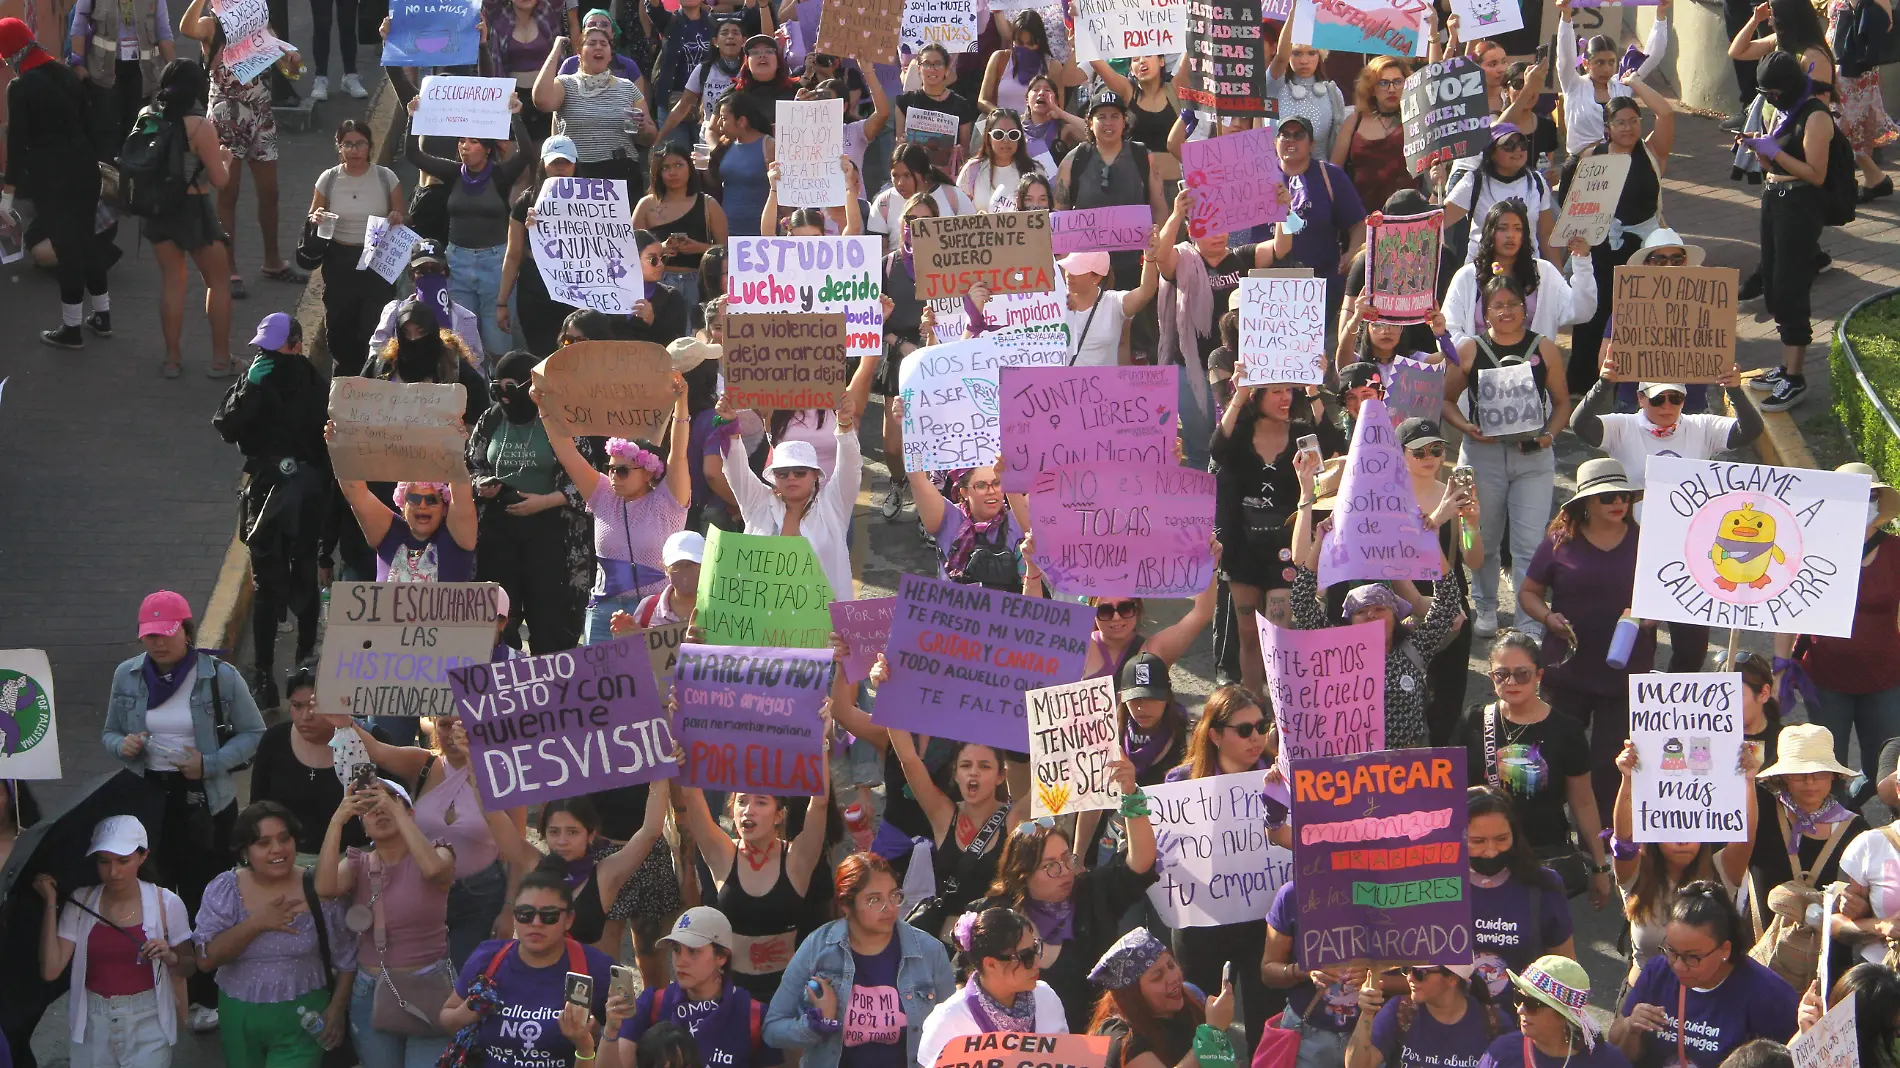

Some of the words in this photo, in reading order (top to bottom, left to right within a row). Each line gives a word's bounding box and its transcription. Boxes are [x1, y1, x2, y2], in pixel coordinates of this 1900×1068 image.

[405, 5, 420, 15] NO
[425, 5, 435, 13] LA
[439, 5, 468, 17] MUSA
[941, 1, 971, 12] MUJER
[1241, 8, 1253, 21] A
[951, 15, 963, 24] de
[1139, 9, 1178, 27] VIENE
[1100, 36, 1114, 52] LA
[1189, 58, 1197, 71] Y
[1213, 61, 1224, 76] A
[1226, 63, 1254, 78] LOS
[1101, 93, 1116, 103] GAP
[1425, 71, 1484, 106] VOZ
[1410, 121, 1420, 137] DE
[1425, 103, 1466, 127] QUIEN
[781, 126, 807, 144] HOY
[812, 126, 832, 144] VOY
[778, 145, 785, 160] A
[788, 144, 822, 160] GRITAR
[828, 144, 840, 158] LO
[1189, 142, 1222, 169] UN
[1228, 129, 1275, 159] TAXI
[823, 161, 837, 175] TE
[791, 190, 830, 205] CALLAR
[1231, 182, 1251, 204] NO
[1258, 177, 1273, 195] ES
[536, 201, 561, 216] QUE
[568, 203, 617, 218] NADIE
[558, 221, 592, 237] HAGA
[912, 220, 930, 238] LA
[932, 215, 991, 234] TERAPIA
[997, 215, 1017, 229] NO
[1027, 214, 1045, 229] ES
[939, 231, 1026, 250] SUFICIENTE
[563, 261, 573, 269] DE
[580, 260, 591, 268] LO
[737, 239, 865, 273] ESTUDIO
[932, 249, 992, 268] QUIERO
[544, 268, 620, 286] VALIOSA
[727, 274, 796, 305] Lucho
[818, 271, 880, 303] decido
[926, 266, 1052, 297] JUSTICIA
[1269, 280, 1325, 303] ESTOY
[1618, 274, 1646, 299] MI
[1652, 275, 1671, 299] YO
[1676, 276, 1728, 309] ADULTA
[1261, 303, 1290, 318] POR
[1294, 305, 1319, 322] LAS
[1616, 302, 1659, 326] GRITA
[1666, 302, 1688, 327] POR
[727, 318, 754, 339] La
[761, 318, 838, 338] violencia
[1243, 317, 1298, 337] NIÑAS
[1612, 326, 1690, 348] ADOLESCENTE
[1715, 329, 1727, 348] LE
[1244, 334, 1255, 348] A
[1258, 336, 1287, 350] LAS
[1290, 340, 1318, 353] QUE
[729, 344, 770, 366] deja
[1243, 352, 1269, 367] NO
[1275, 356, 1304, 370] LES
[726, 362, 810, 383] ignorarla
[814, 364, 845, 385] deja
[920, 355, 963, 380] NOS
[584, 382, 653, 400] VALIENTE
[921, 390, 931, 408] A
[934, 387, 966, 405] SER
[564, 404, 593, 424] SOY
[607, 408, 665, 427] MUJER
[1080, 396, 1149, 430] LIBRES
[919, 415, 964, 436] Pero
[384, 443, 427, 459] MUNDO
[904, 440, 930, 454] BRX
[938, 436, 996, 465] SER
[1074, 506, 1152, 536] TODAS
[1796, 499, 1825, 528] A
[1357, 517, 1382, 535] de
[736, 549, 797, 576] MIEDO
[1082, 574, 1097, 588] de
[1135, 556, 1200, 589] ABUSO
[709, 576, 808, 609] LIBERTAD
[1767, 555, 1838, 626] PERRO
[346, 585, 383, 622] SI
[393, 585, 498, 623] ESCUCHARAS
[844, 604, 875, 622] POR
[904, 580, 991, 612] HERMANA
[1001, 596, 1071, 626] PERDIDA
[400, 626, 438, 647] LAS
[841, 628, 867, 640] POR
[907, 604, 927, 622] TE
[930, 610, 980, 635] PRESTO
[988, 624, 1008, 639] MI
[1014, 627, 1047, 647] VOZ
[1049, 635, 1087, 655] PARA
[918, 630, 983, 662] GRITAR
[984, 644, 993, 663] Y
[994, 648, 1060, 676] CANTAR
[449, 665, 489, 696] YO
[491, 653, 575, 691] ELIJO
[677, 653, 784, 687] MARCHO
[785, 658, 831, 690] HOY
[898, 650, 940, 675] TODO
[944, 664, 1010, 688] AQUELLO
[1014, 677, 1044, 692] QUE
[36, 694, 48, 710] POR
[462, 684, 549, 721] VISTO
[684, 688, 707, 706] con
[740, 691, 795, 716] amigas
[919, 687, 944, 705] TE
[1324, 675, 1375, 709] cielo
[1637, 681, 1735, 711] menos
[1032, 684, 1113, 725] MUJERES
[20, 713, 48, 749] PALESTINA
[683, 717, 707, 732] para
[722, 720, 764, 732] marchar
[766, 724, 811, 737] mañana
[1632, 707, 1733, 733] machines
[1035, 713, 1116, 754] TENÍAMOS
[483, 717, 677, 798] DESVISTO
[690, 740, 737, 786] POR
[745, 744, 822, 792] ELLAS
[1037, 759, 1069, 787] QUE
[1197, 786, 1222, 821] tu
[1658, 778, 1716, 807] más
[1362, 797, 1380, 816] y
[1639, 800, 1743, 832] ternurines
[1180, 834, 1213, 859] no
[1302, 857, 1325, 876] el
[1163, 873, 1195, 908] tu
[1355, 878, 1459, 907] MUJERES
[1475, 917, 1518, 931] cuidan
[1304, 924, 1468, 966] PATRIARCADO
[1476, 932, 1519, 946] amigas
[853, 993, 873, 1010] POR
[879, 994, 893, 1010] MI
[884, 1011, 895, 1026] ti
[1684, 1021, 1720, 1037] cuidan
[846, 1030, 863, 1042] POR
[868, 1032, 897, 1041] TODAS
[964, 1034, 1057, 1053] HACEN
[1656, 1030, 1678, 1042] mis
[1683, 1035, 1719, 1051] amigas
[491, 1045, 513, 1055] me
[521, 1048, 551, 1058] veo
[1401, 1045, 1421, 1062] Por
[1425, 1054, 1440, 1064] mi
